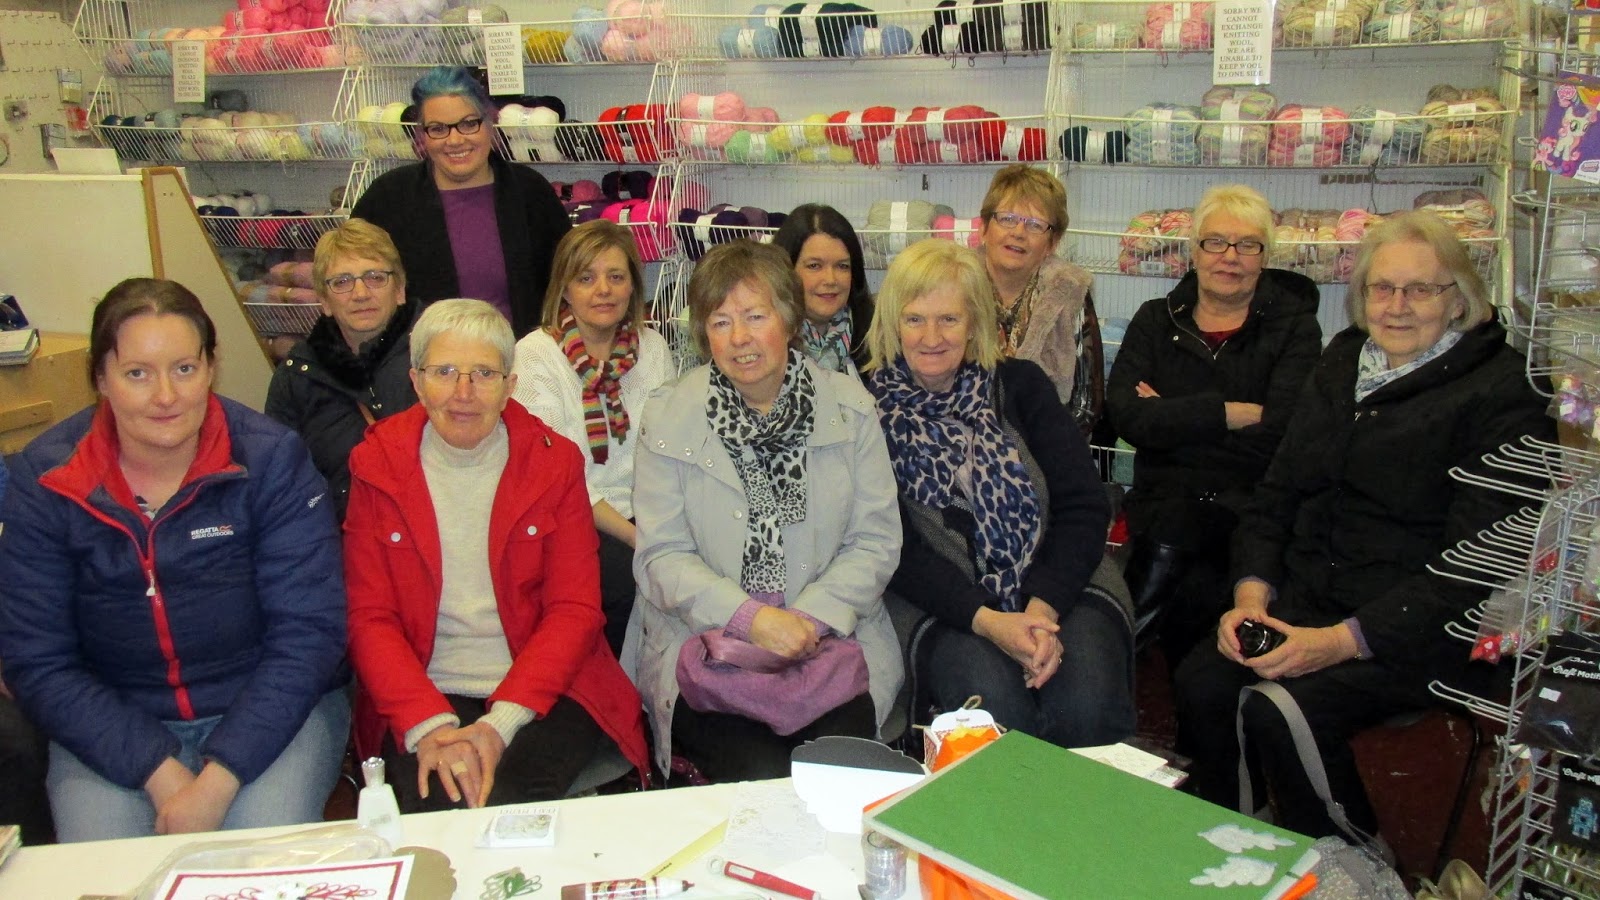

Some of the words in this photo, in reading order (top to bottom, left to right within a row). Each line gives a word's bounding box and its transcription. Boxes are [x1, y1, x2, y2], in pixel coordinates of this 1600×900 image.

[1223, 7, 1249, 15] SORRY
[1221, 23, 1263, 31] EXCHANGE
[190, 526, 219, 536] REGATTA
[206, 530, 234, 538] OUTDOORS
[1552, 665, 1578, 678] Craft
